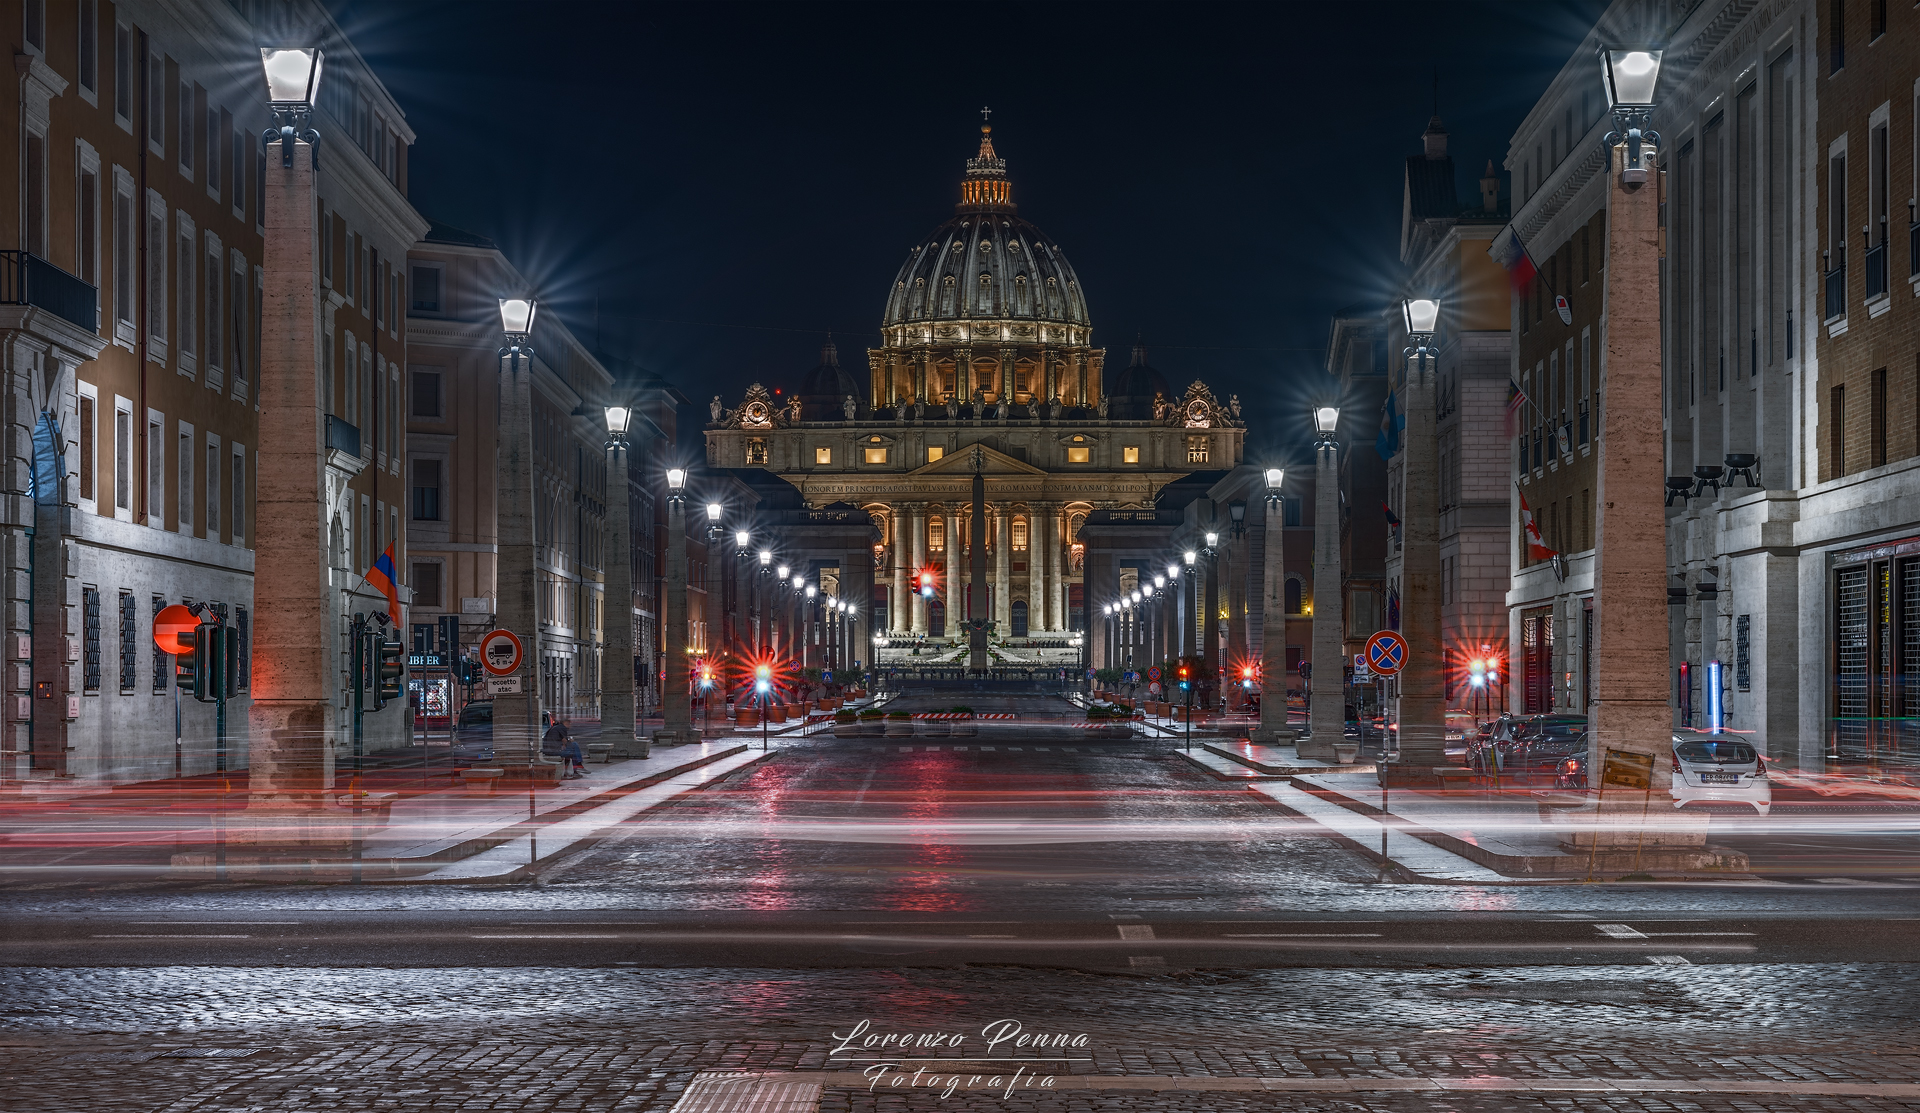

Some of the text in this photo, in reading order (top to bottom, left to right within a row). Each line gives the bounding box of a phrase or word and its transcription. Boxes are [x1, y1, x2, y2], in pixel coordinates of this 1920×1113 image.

[913, 484, 941, 492] PAVLVS
[1000, 484, 1041, 492] ROMANVS
[496, 658, 500, 666] 6
[492, 678, 517, 686] eccetto
